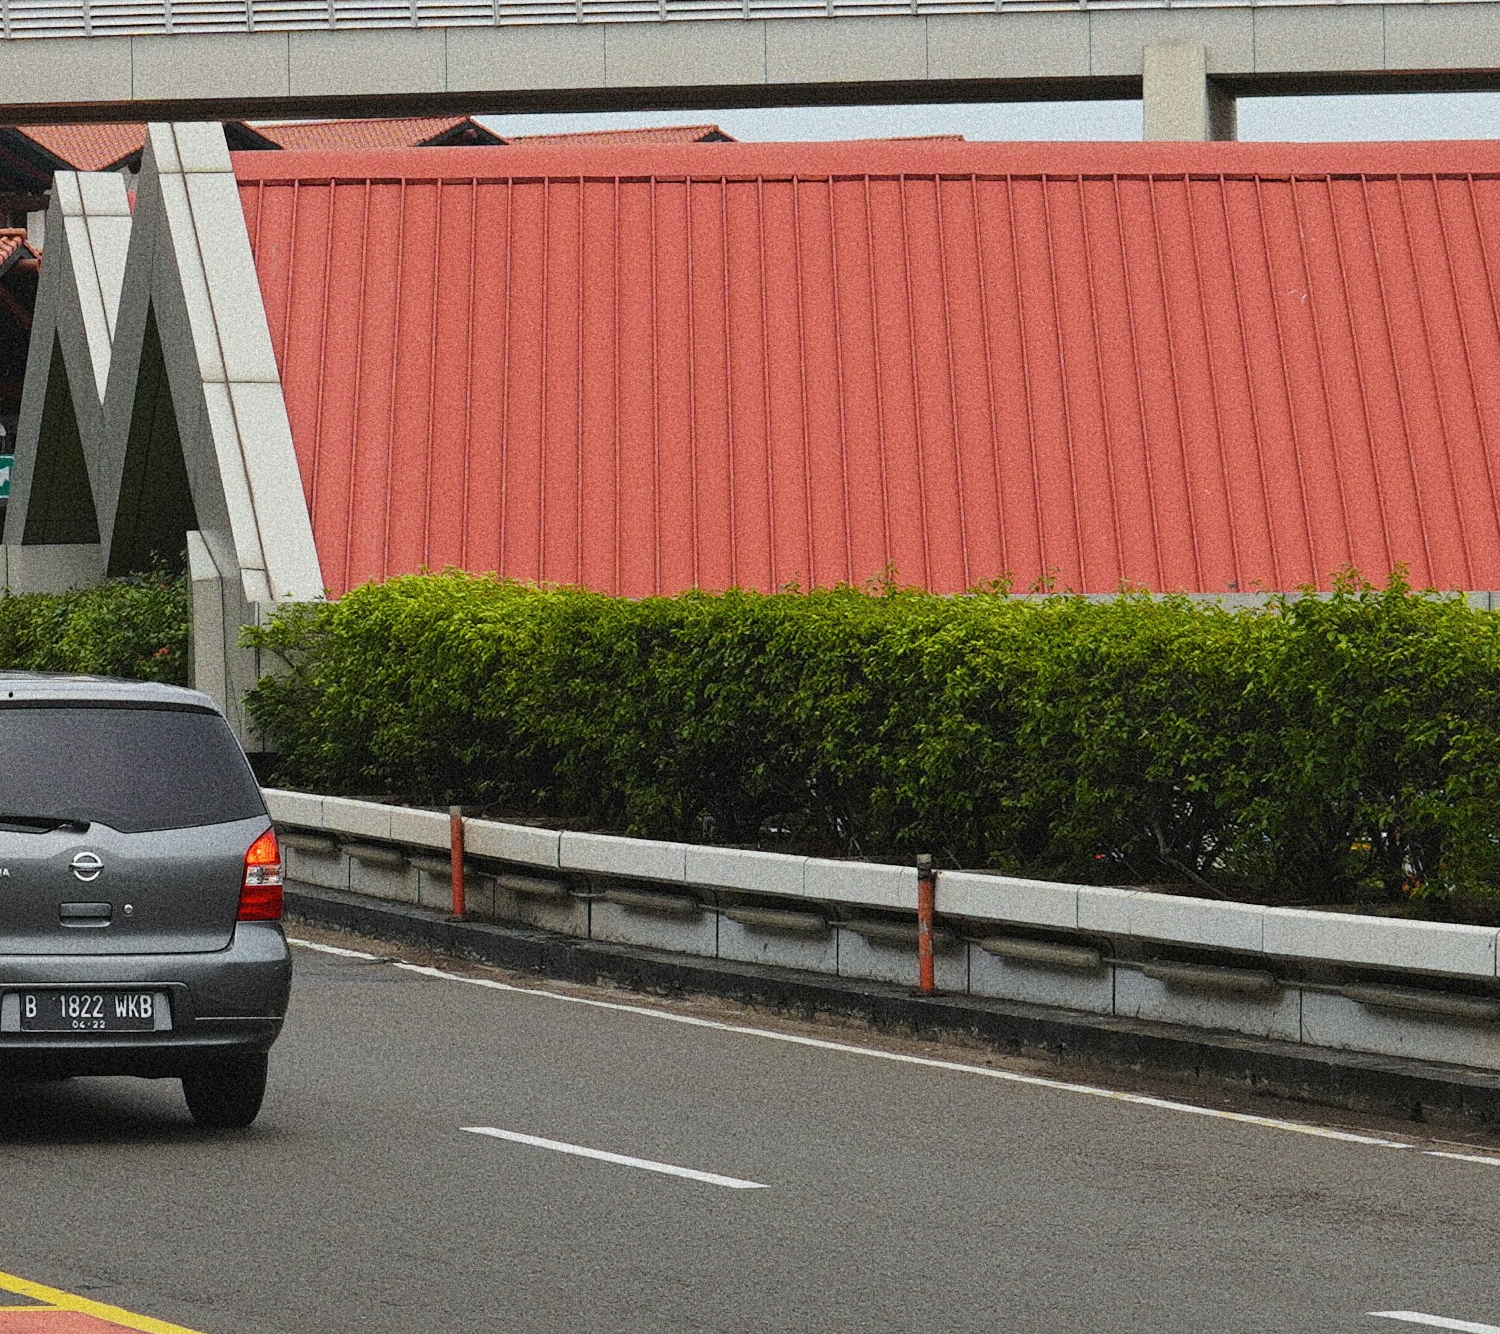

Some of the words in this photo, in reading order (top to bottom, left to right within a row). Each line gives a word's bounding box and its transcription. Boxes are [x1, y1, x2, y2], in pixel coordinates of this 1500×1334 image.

[25, 995, 37, 1018] B
[60, 995, 104, 1018] 1822
[114, 995, 152, 1018] WKB
